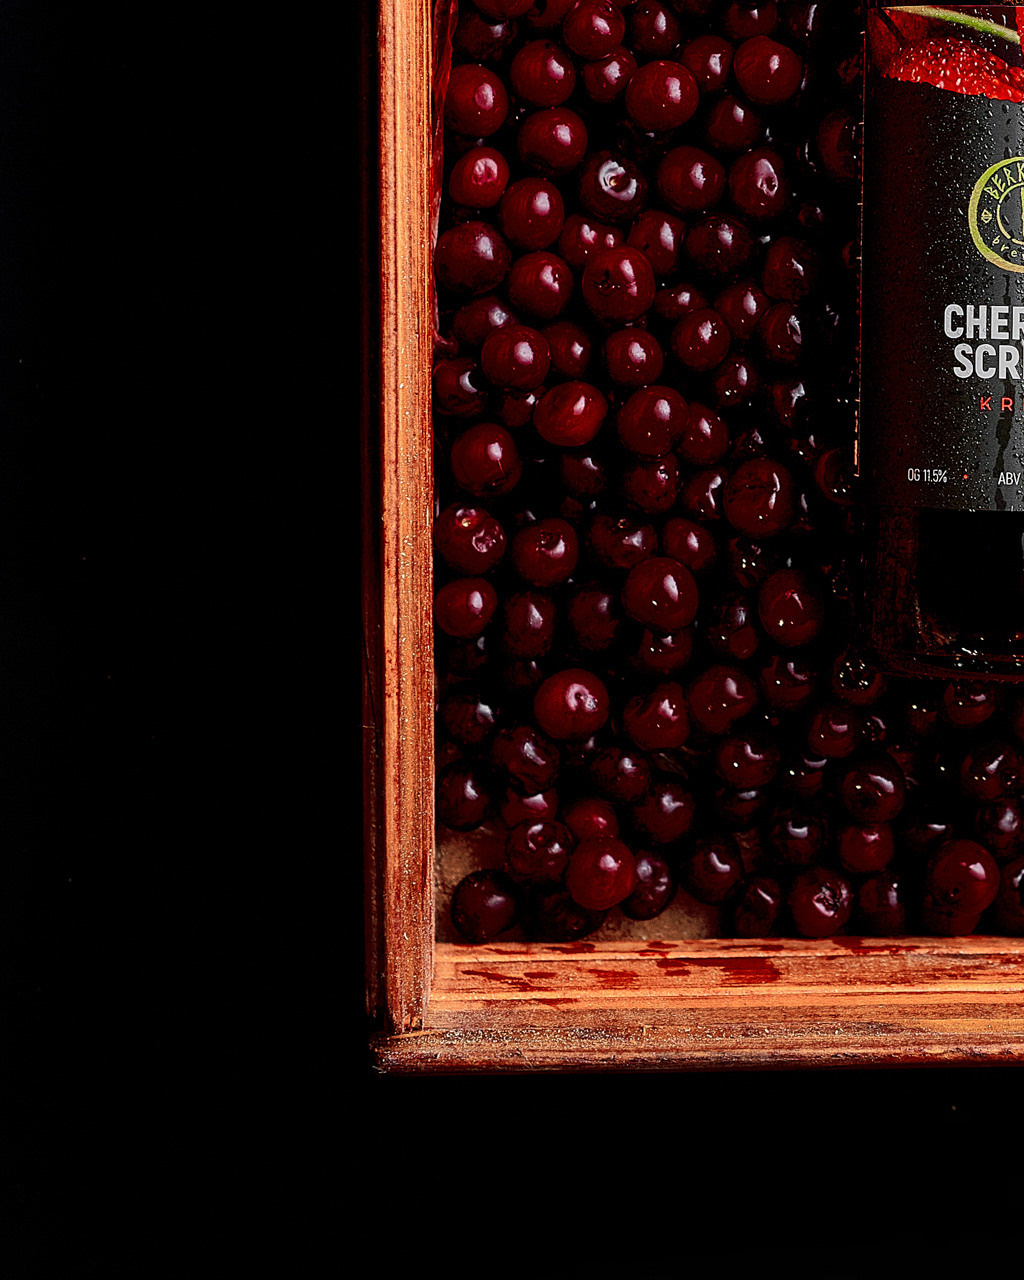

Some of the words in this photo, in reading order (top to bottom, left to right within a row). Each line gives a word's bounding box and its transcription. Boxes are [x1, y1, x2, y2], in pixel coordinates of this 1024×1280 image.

[907, 467, 921, 482] OG
[923, 468, 948, 483] 11.5%
[997, 471, 1021, 486] ABV
